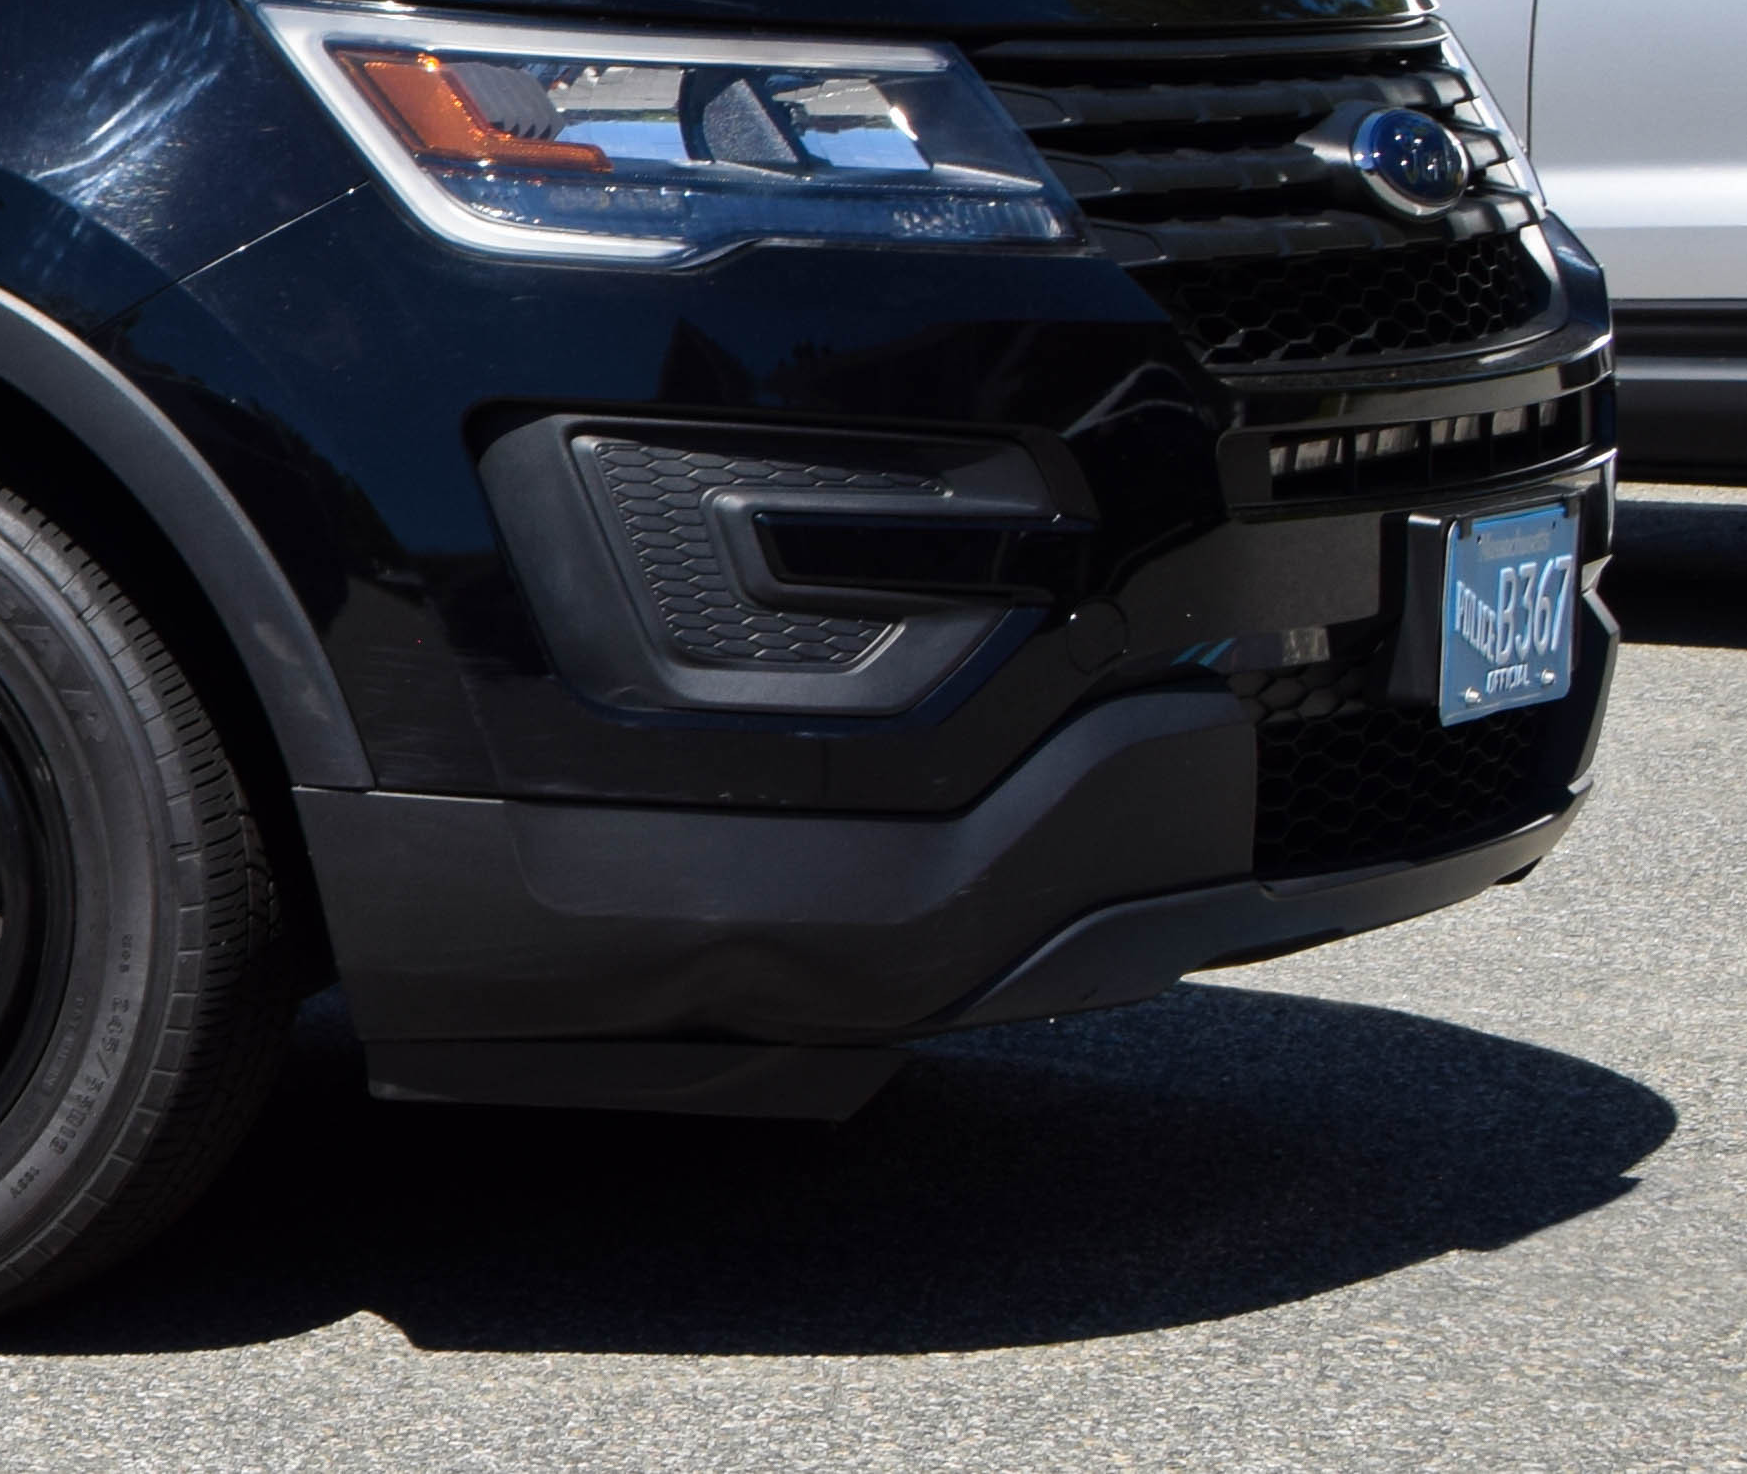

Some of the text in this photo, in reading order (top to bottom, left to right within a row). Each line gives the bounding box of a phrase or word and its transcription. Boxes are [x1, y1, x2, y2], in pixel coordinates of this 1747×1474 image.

[1455, 554, 1573, 666] POLICE B367
[1486, 662, 1531, 695] OFFICIAL
